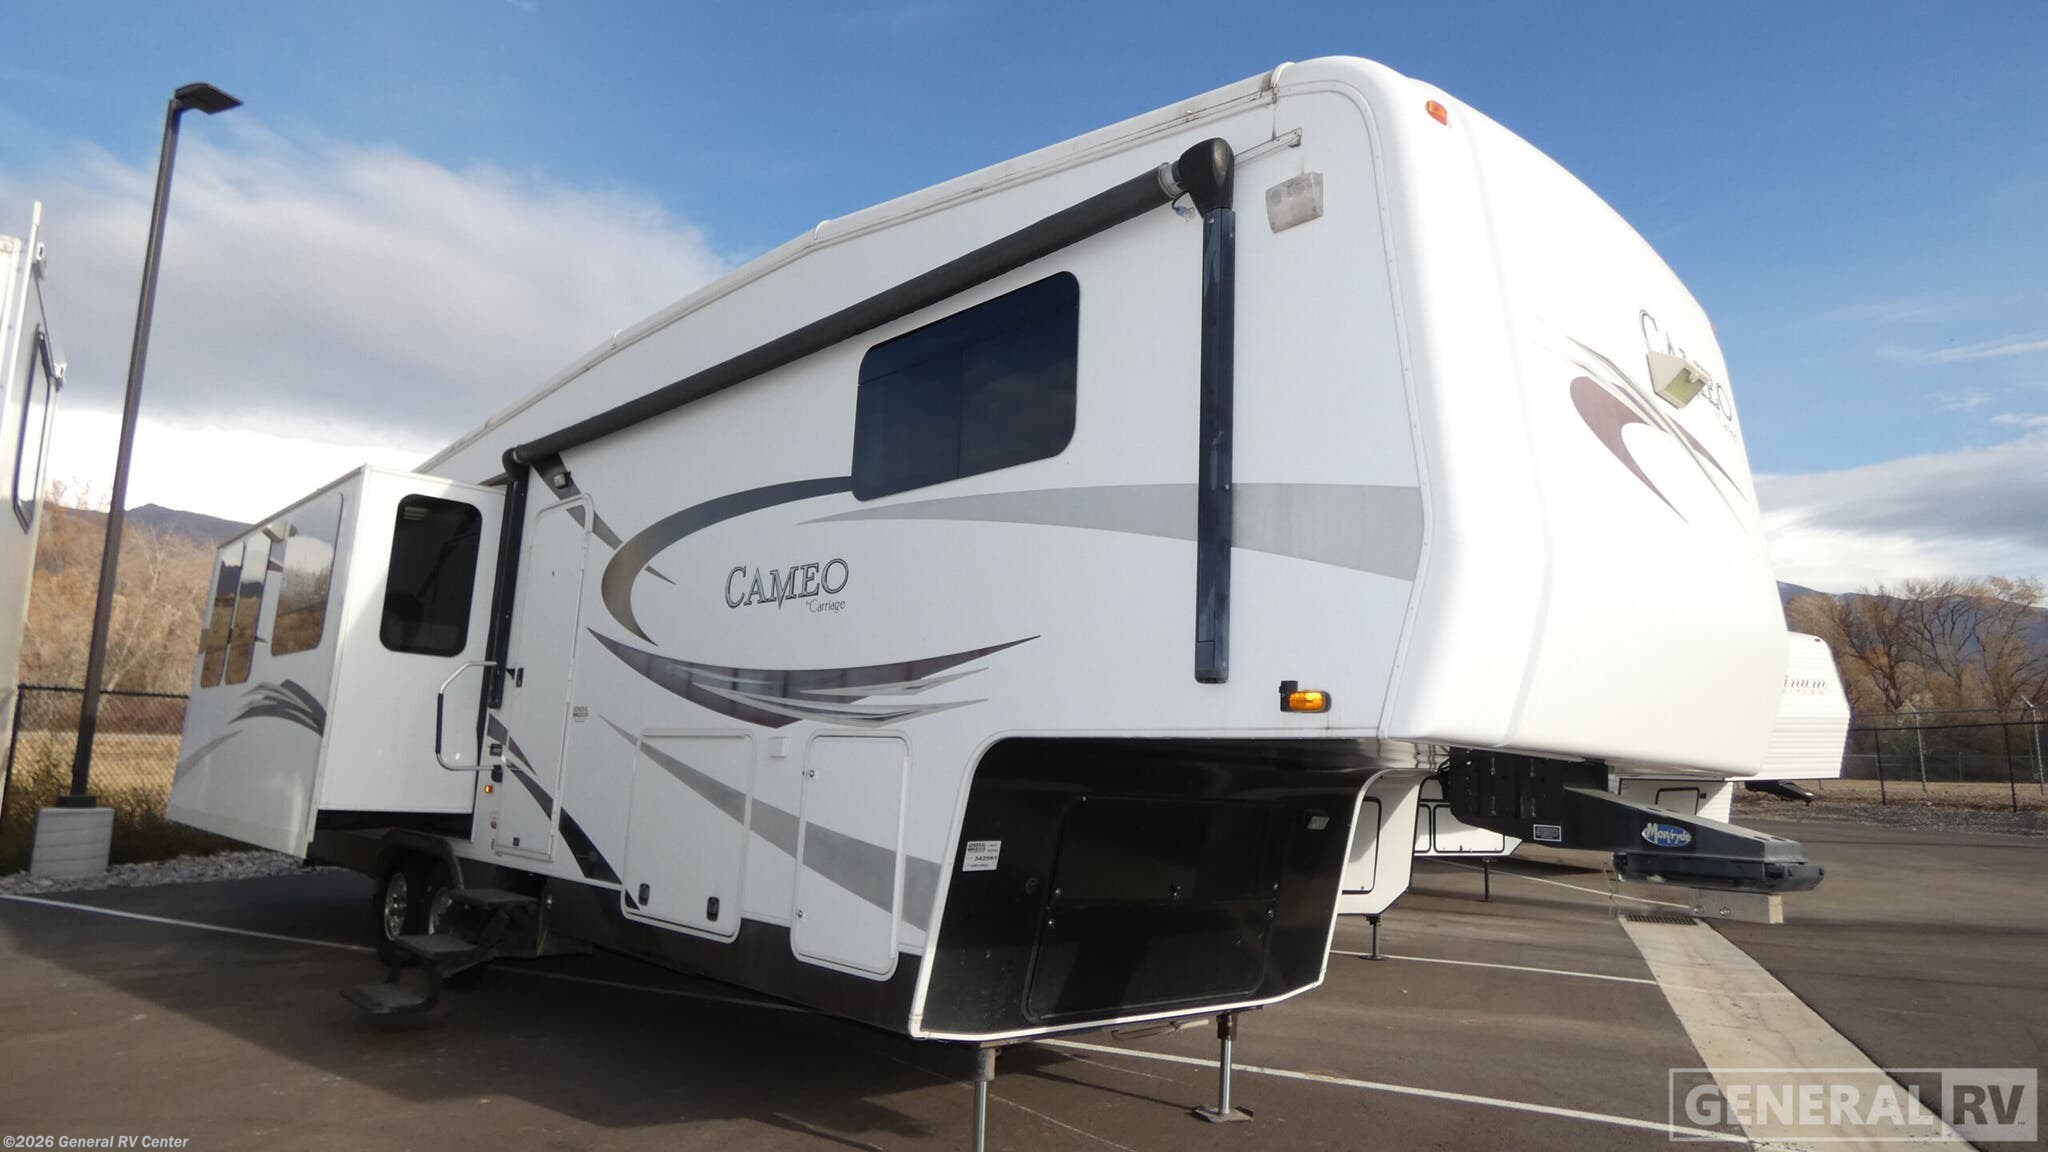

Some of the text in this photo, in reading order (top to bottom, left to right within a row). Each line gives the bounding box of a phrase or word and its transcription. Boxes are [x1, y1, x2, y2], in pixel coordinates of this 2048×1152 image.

[724, 558, 849, 610] CAMEO
[809, 598, 846, 614] Carriage
[1783, 675, 1828, 689] inum
